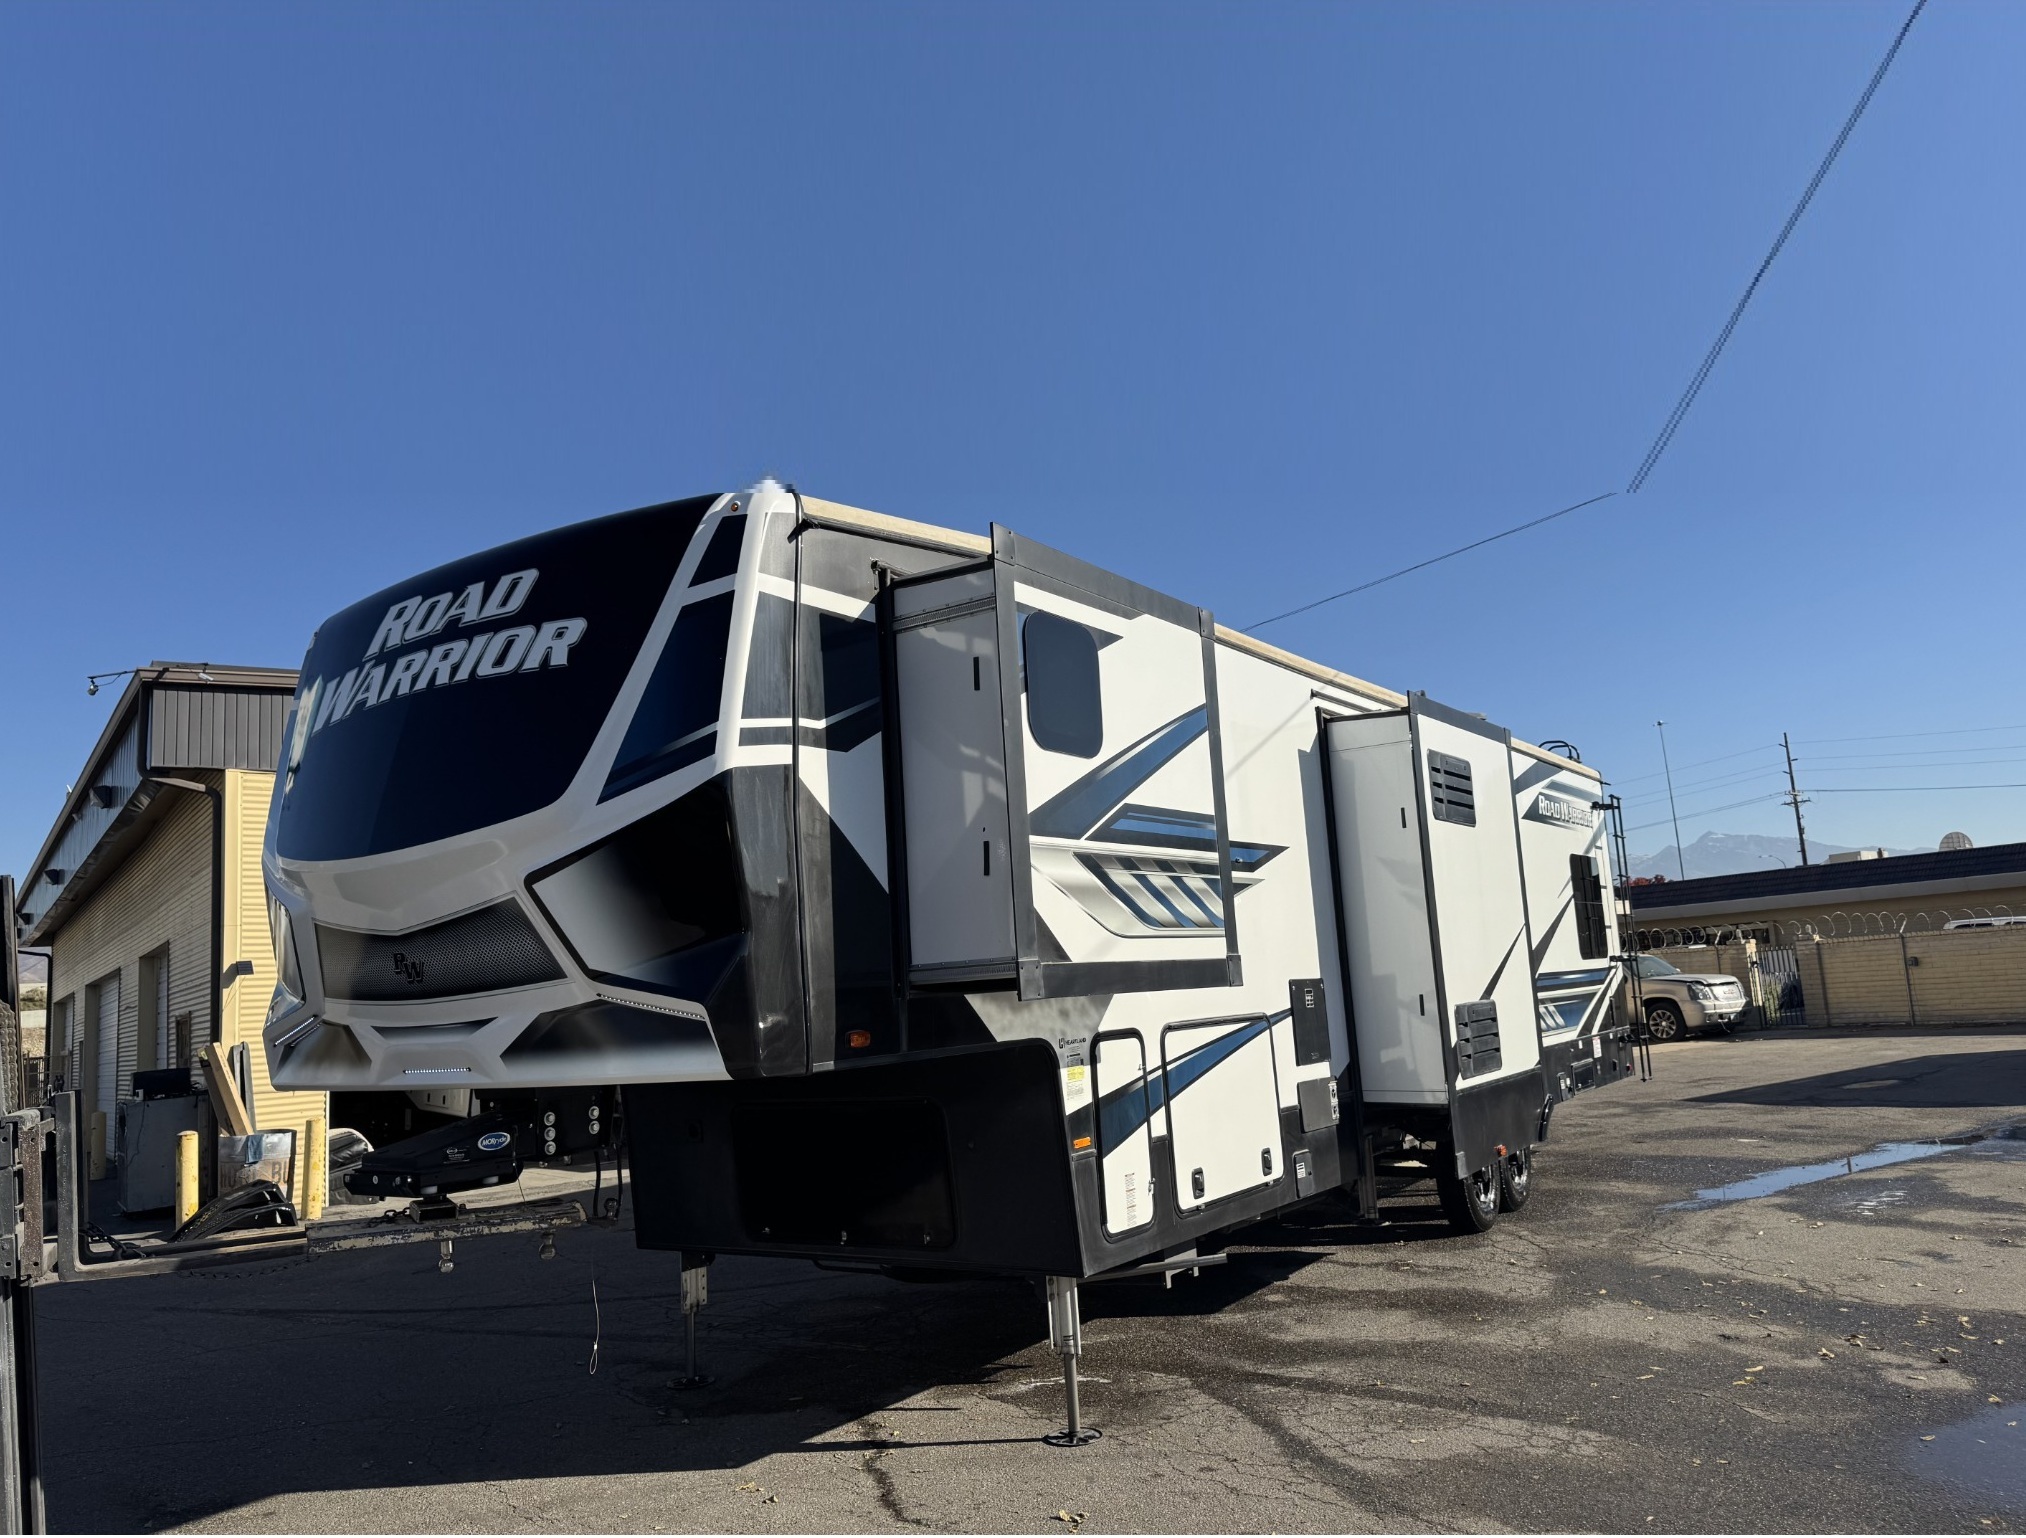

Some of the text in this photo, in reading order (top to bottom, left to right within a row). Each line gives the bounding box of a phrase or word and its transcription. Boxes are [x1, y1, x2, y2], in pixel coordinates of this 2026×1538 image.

[362, 568, 540, 662] ROAD
[311, 617, 588, 737] WARRIOR
[1538, 794, 1560, 819] ROAD
[1065, 1037, 1087, 1045] HEARTLAND
